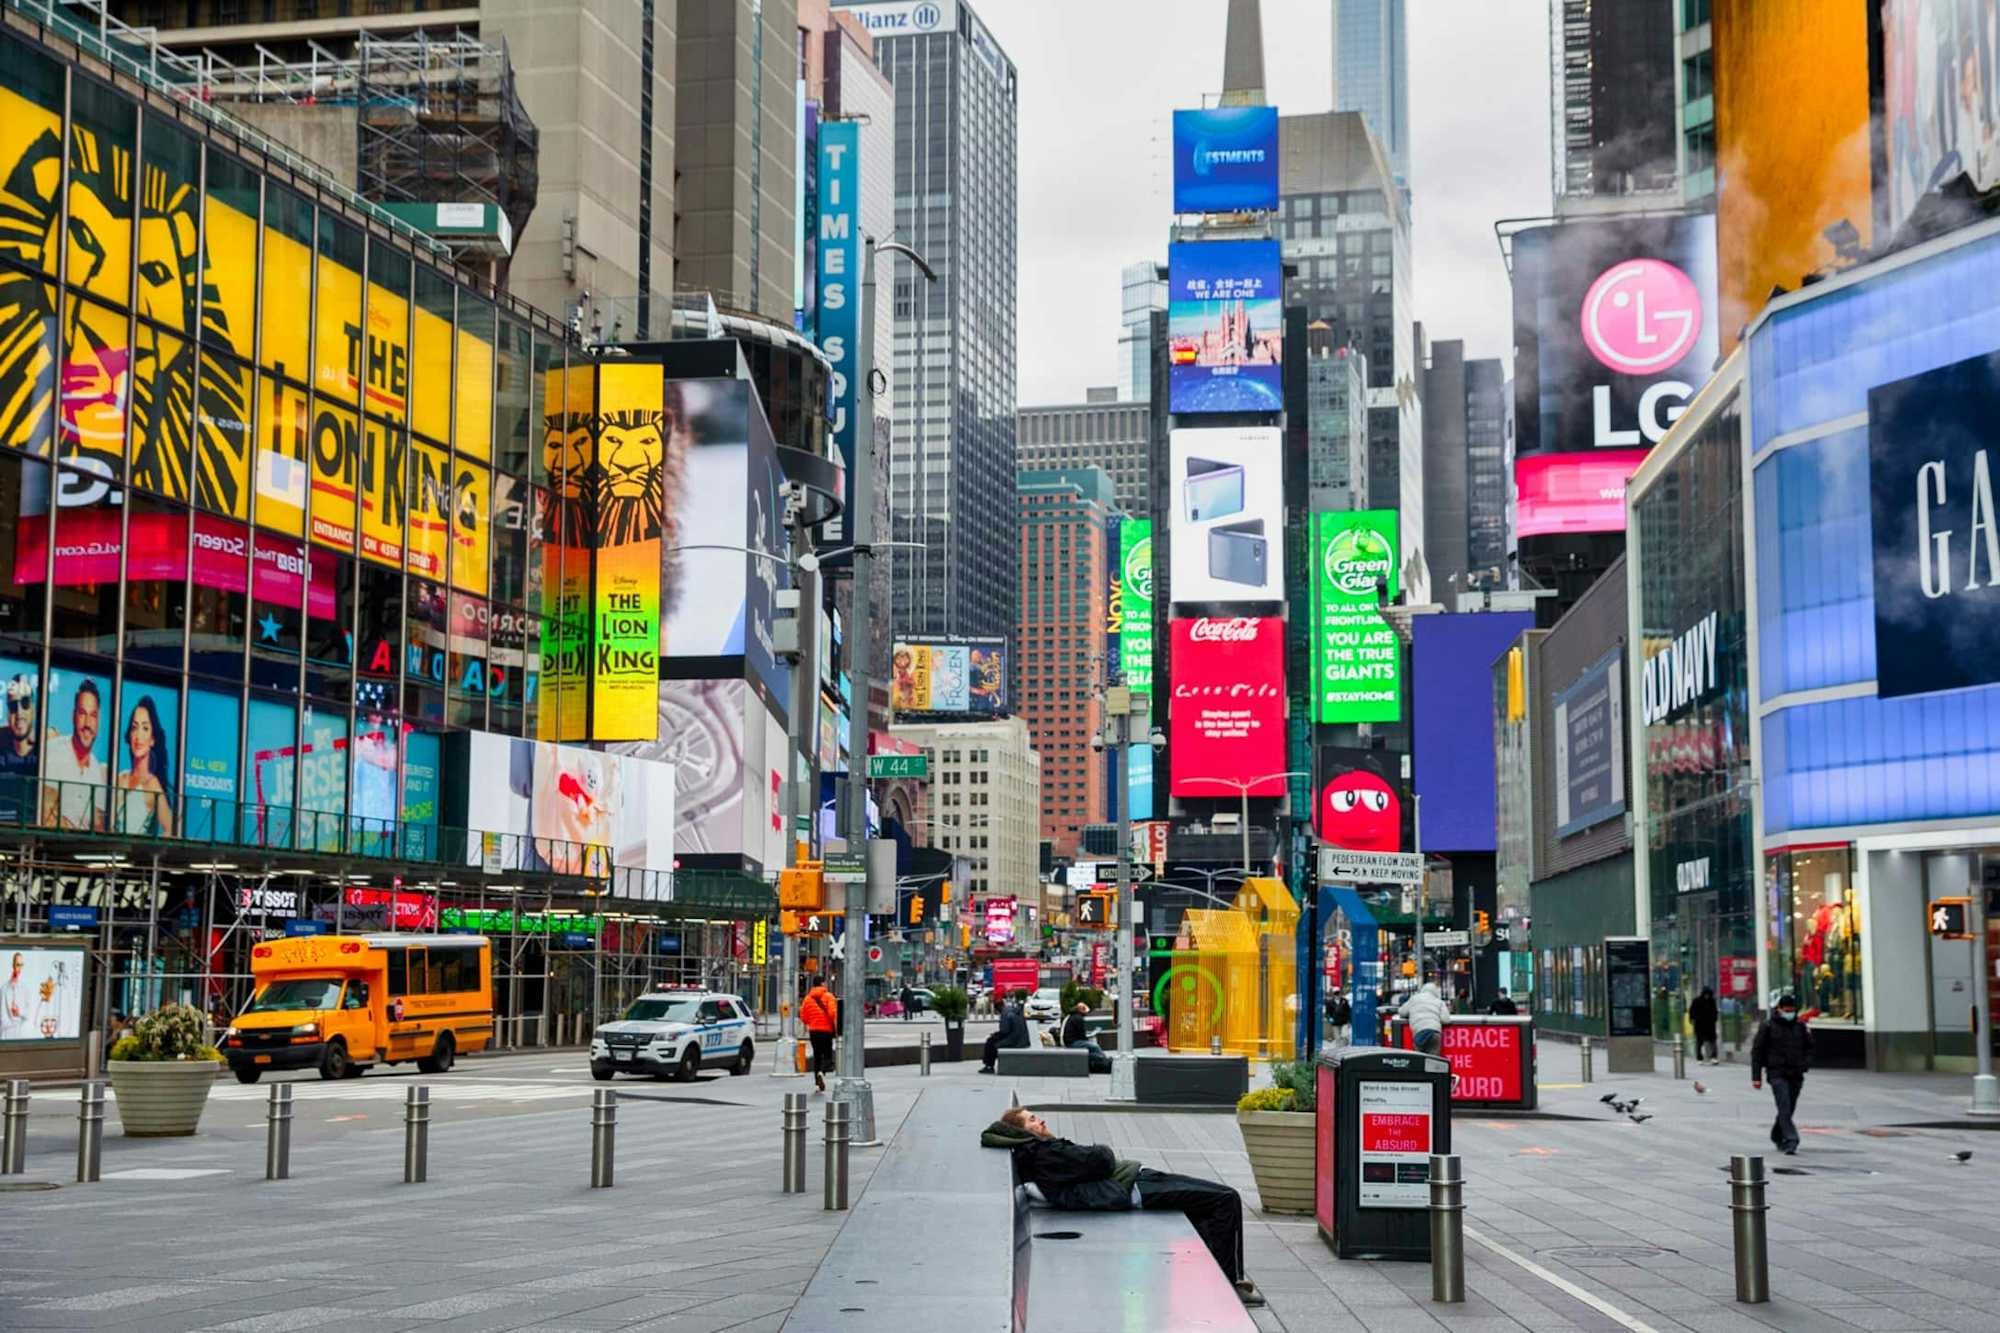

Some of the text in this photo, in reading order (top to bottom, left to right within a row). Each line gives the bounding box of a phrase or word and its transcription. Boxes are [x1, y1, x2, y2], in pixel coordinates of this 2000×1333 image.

[821, 144, 848, 310] TIMES
[1194, 289, 1255, 299] WE ARE ONE
[343, 320, 405, 397] THE
[1333, 559, 1388, 574] Green
[608, 594, 641, 610] THE
[602, 613, 649, 641] LION
[1189, 616, 1262, 642] Coca-Cola
[1326, 630, 1394, 646] YOU ARE
[597, 643, 656, 676] KING
[1326, 647, 1394, 662] THE TRUE
[1325, 663, 1394, 681] GIANTS
[1641, 610, 1718, 727] OLD NAVY
[872, 758, 884, 775] W
[889, 759, 909, 775] 44
[1331, 853, 1421, 868] PEDESTRIAN FLOW ZONE
[1370, 868, 1420, 881] KEEP MOVING
[1371, 1115, 1421, 1127] EMBRACE
[1375, 1139, 1418, 1151] ABSURD
